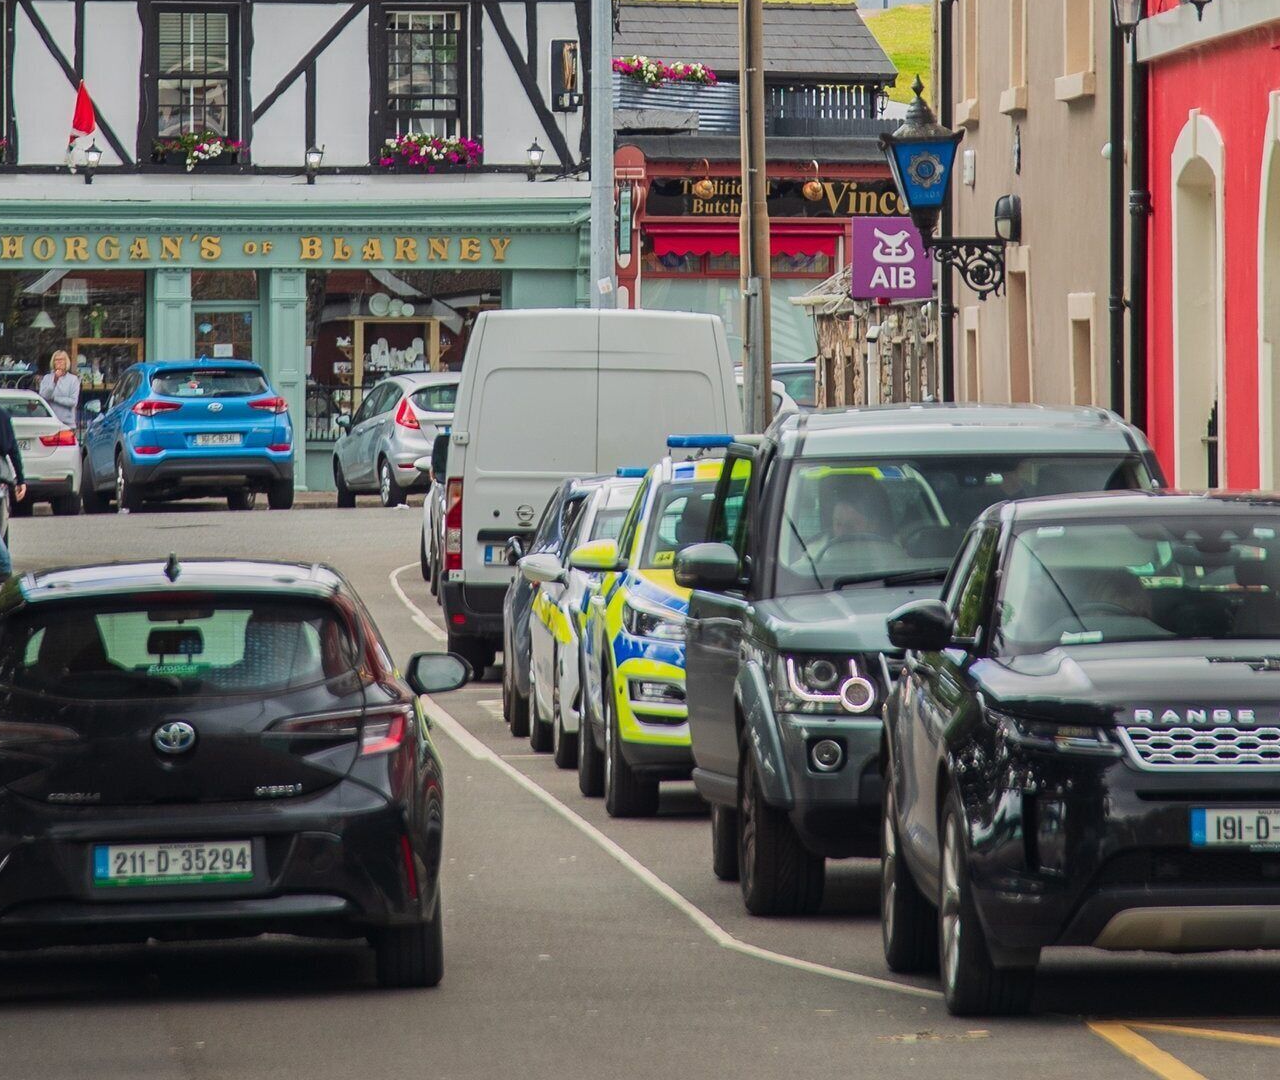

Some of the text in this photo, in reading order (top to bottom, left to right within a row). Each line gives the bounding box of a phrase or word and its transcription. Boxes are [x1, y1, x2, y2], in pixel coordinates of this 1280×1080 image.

[692, 199, 739, 213] Butch
[0, 235, 221, 260] HORGAN'S
[300, 236, 511, 261] BLARNEY
[869, 266, 916, 289] AIB
[148, 663, 199, 675] Europcar
[1134, 709, 1256, 723] RANGE
[114, 846, 248, 875] 211-D-35294
